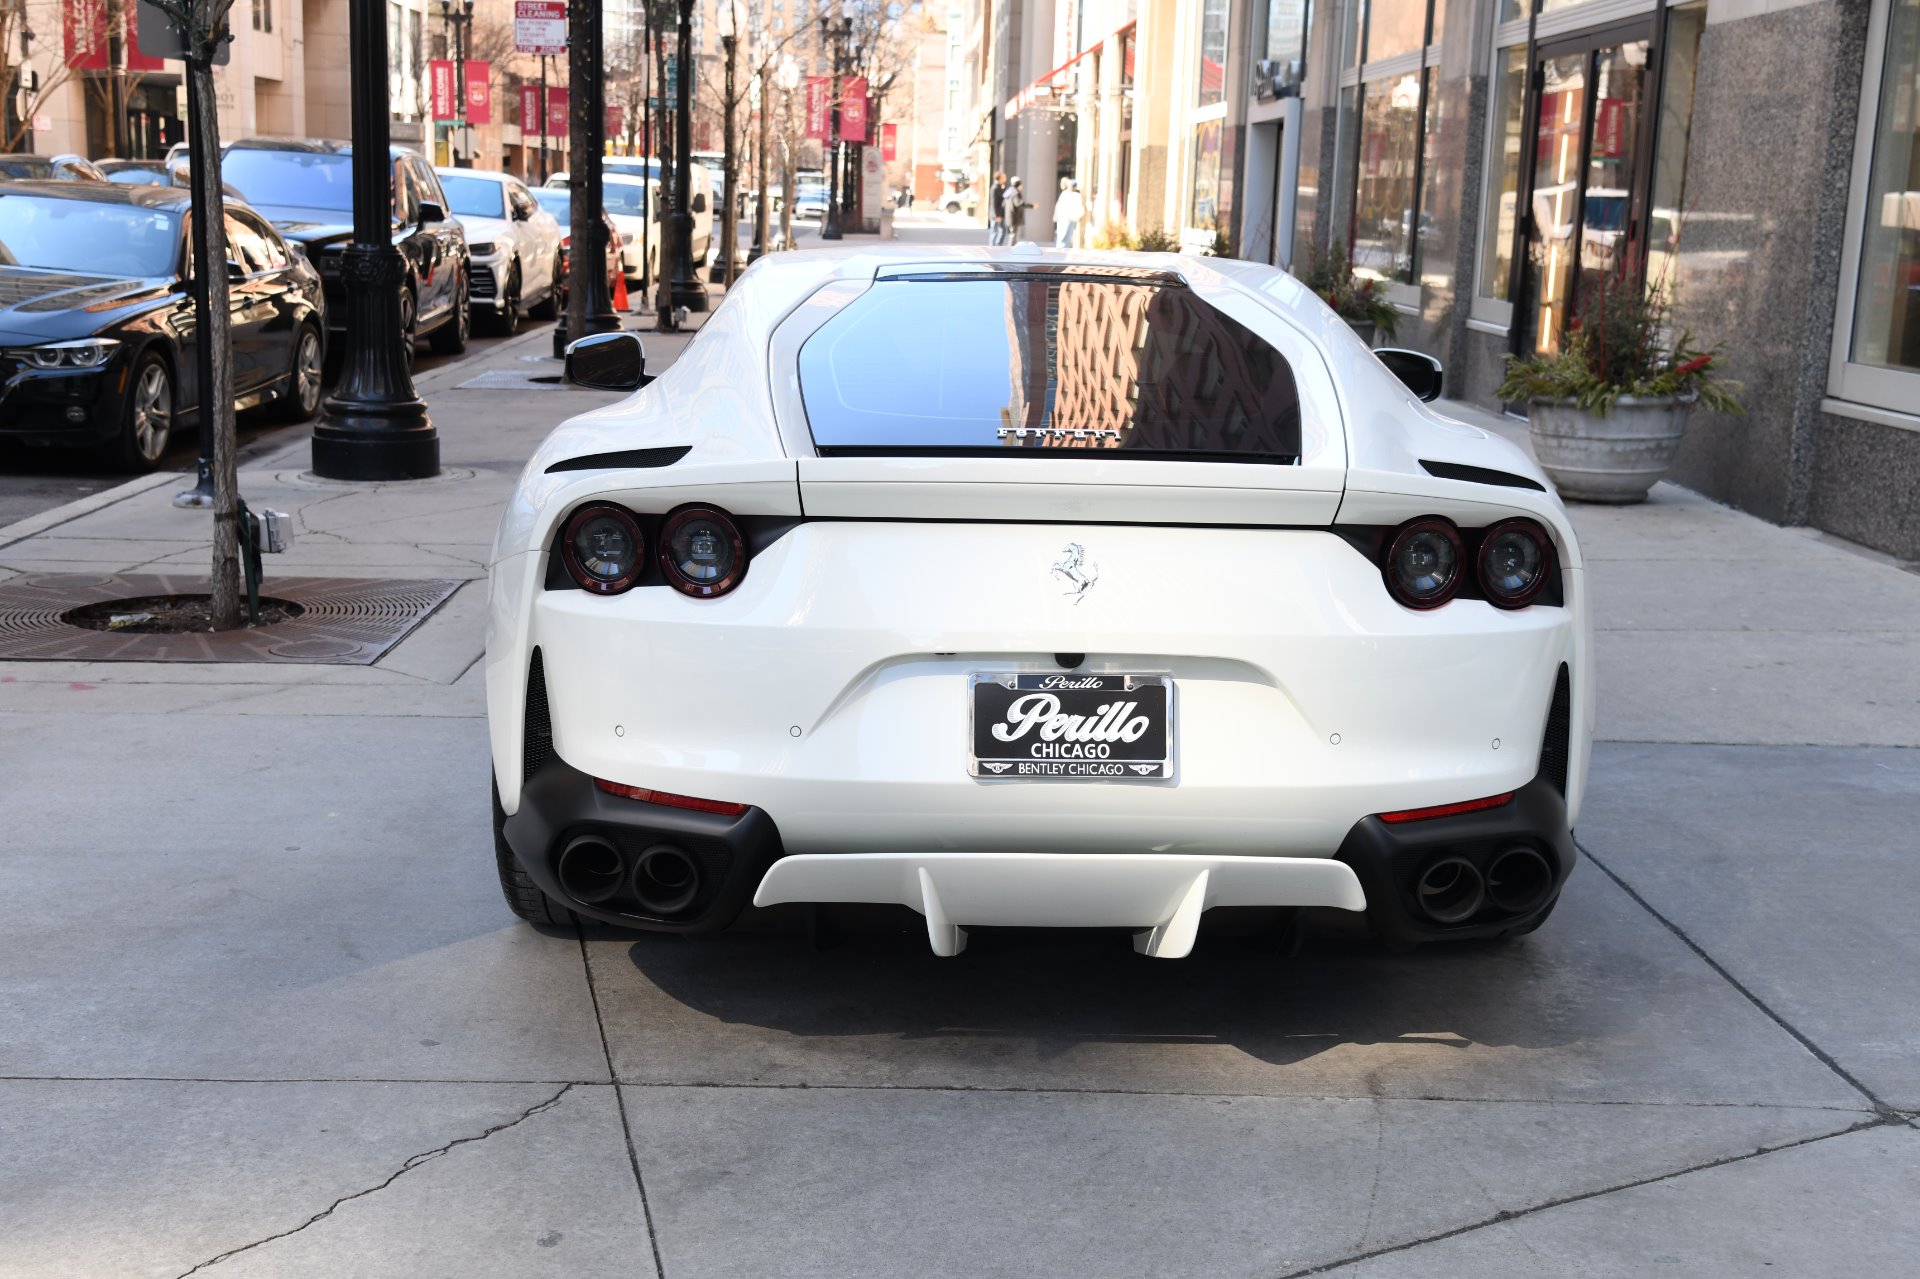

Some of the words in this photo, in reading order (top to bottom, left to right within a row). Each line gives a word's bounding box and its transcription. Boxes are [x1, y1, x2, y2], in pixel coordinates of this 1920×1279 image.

[518, 2, 547, 11] STREET
[518, 10, 561, 18] CLEANING
[73, 0, 87, 53] WELCO
[518, 45, 536, 53] TOW
[541, 46, 561, 54] ZONE
[436, 66, 446, 115] WELCOME
[1039, 675, 1103, 689] Perillo
[991, 693, 1150, 743] Perillo
[1030, 743, 1111, 758] CHICAGO
[1018, 763, 1066, 774] BENTLEY
[1068, 763, 1124, 775] CHICAGO
